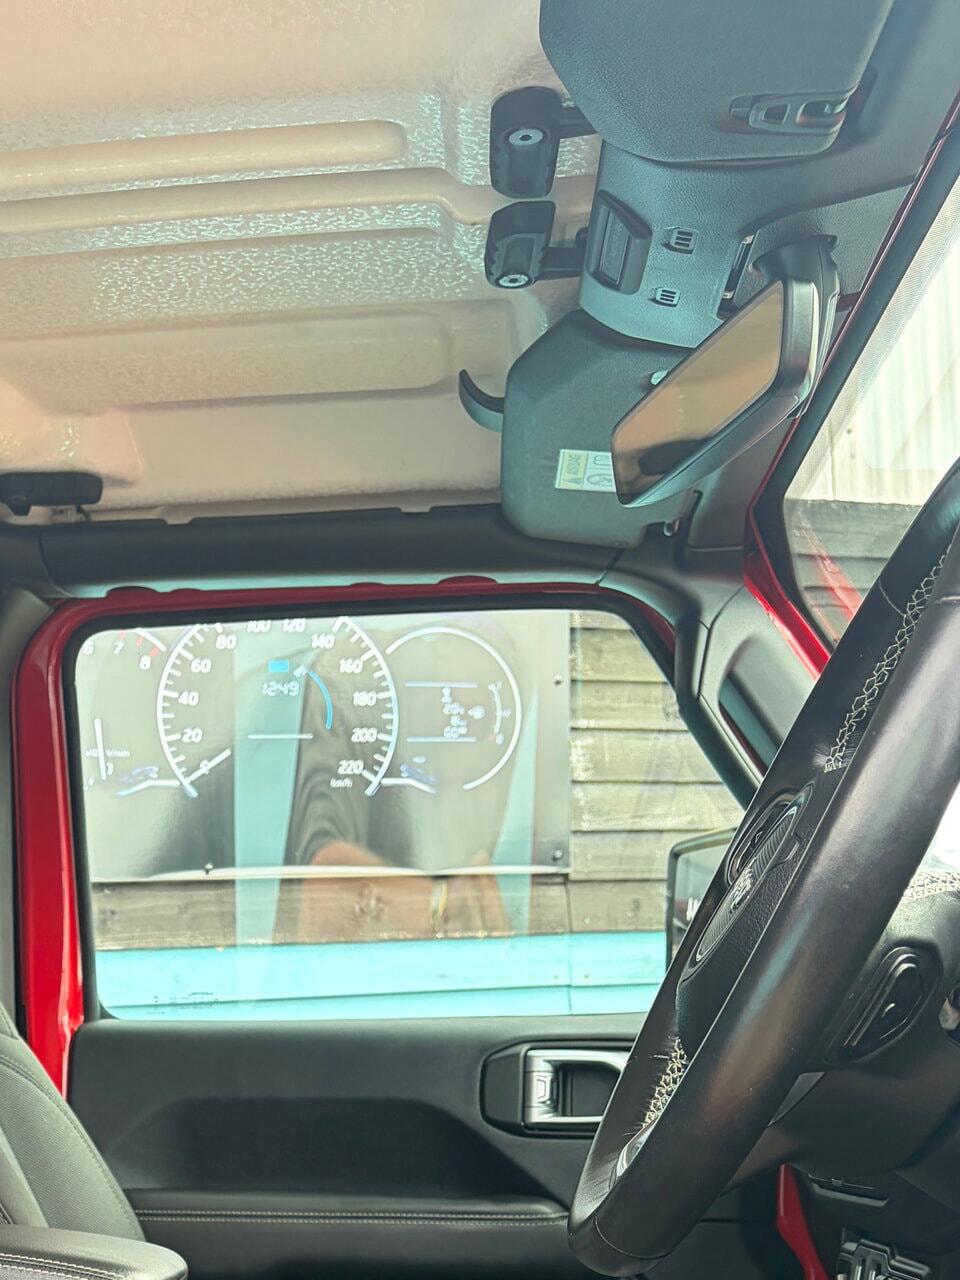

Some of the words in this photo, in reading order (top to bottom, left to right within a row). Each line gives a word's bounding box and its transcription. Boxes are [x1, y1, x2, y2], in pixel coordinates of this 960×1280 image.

[113, 641, 124, 655] 7
[215, 635, 237, 650] 80
[311, 634, 336, 649] 140
[191, 658, 212, 673] 60
[339, 658, 363, 674] 160
[178, 691, 199, 706] 40
[182, 728, 202, 743] 20
[350, 727, 377, 743] 200
[338, 759, 364, 775] 220
